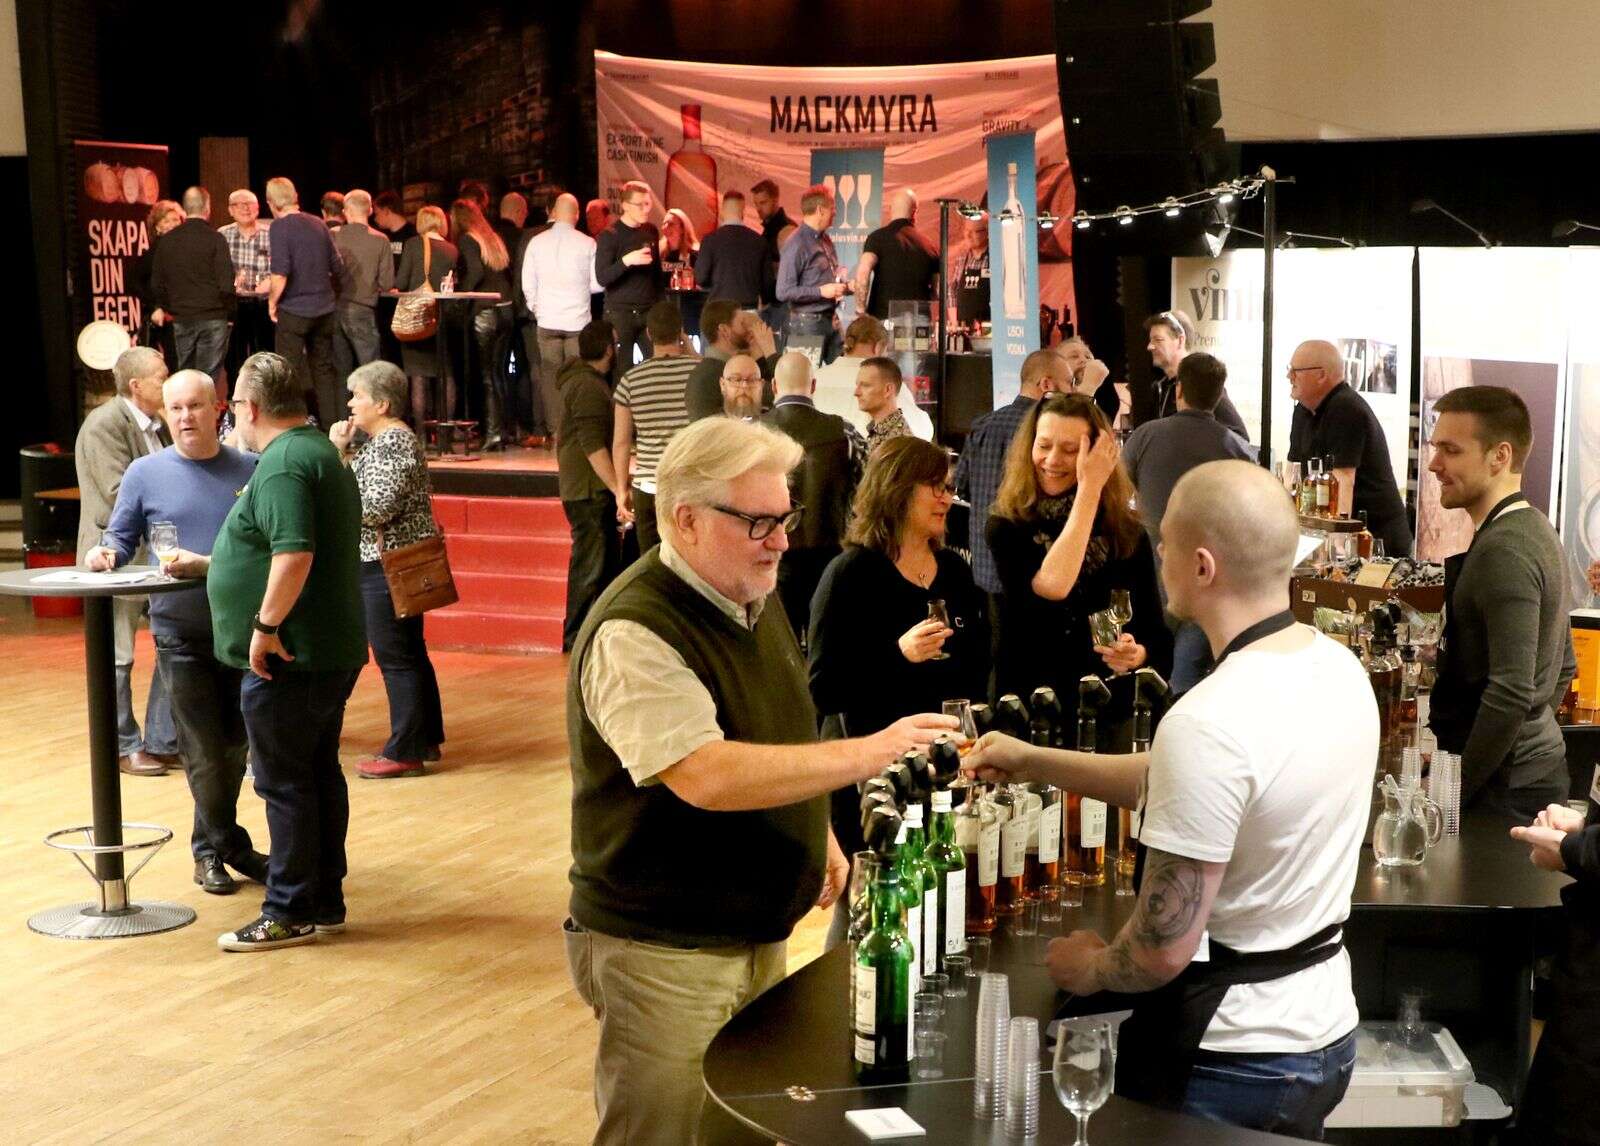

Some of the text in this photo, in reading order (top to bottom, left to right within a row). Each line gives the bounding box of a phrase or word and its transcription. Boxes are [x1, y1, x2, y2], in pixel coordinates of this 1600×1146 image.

[770, 94, 938, 134] MACKMYRA
[88, 219, 150, 256] SKAPA
[91, 258, 125, 294] DIN
[93, 296, 141, 332] EGEN
